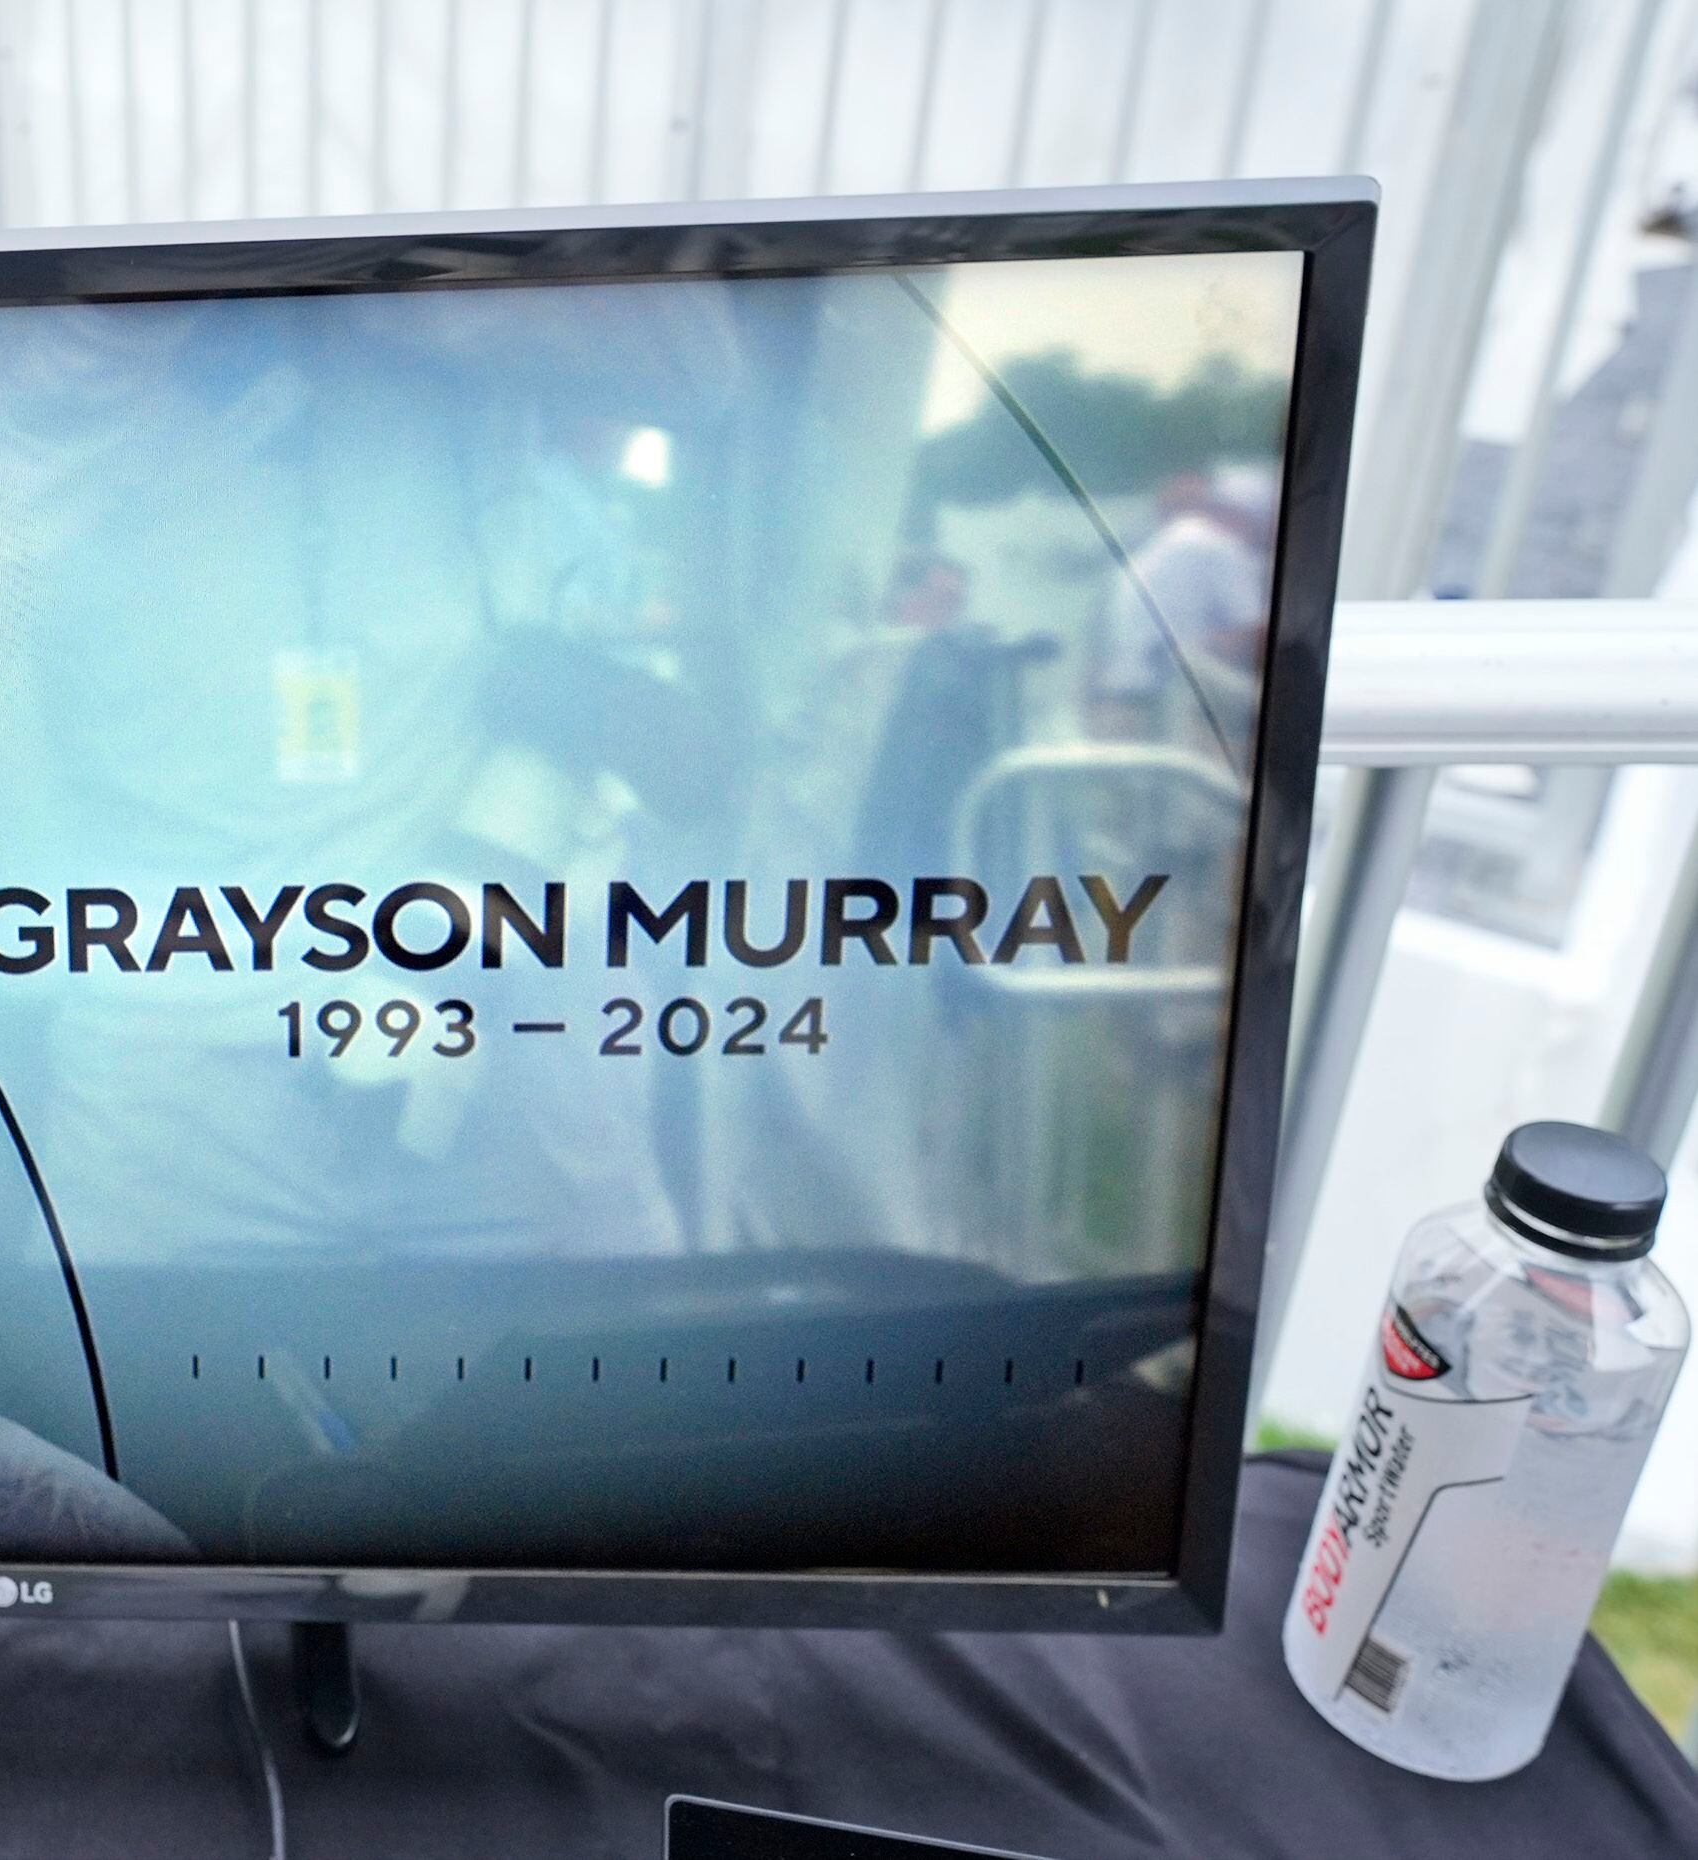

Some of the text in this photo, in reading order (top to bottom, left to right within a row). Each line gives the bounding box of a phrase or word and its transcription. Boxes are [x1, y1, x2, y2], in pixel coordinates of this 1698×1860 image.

[606, 874, 1169, 967] MURRAY
[279, 1000, 478, 1057] 1993
[599, 998, 829, 1055] 2024
[20, 1581, 53, 1604] LG
